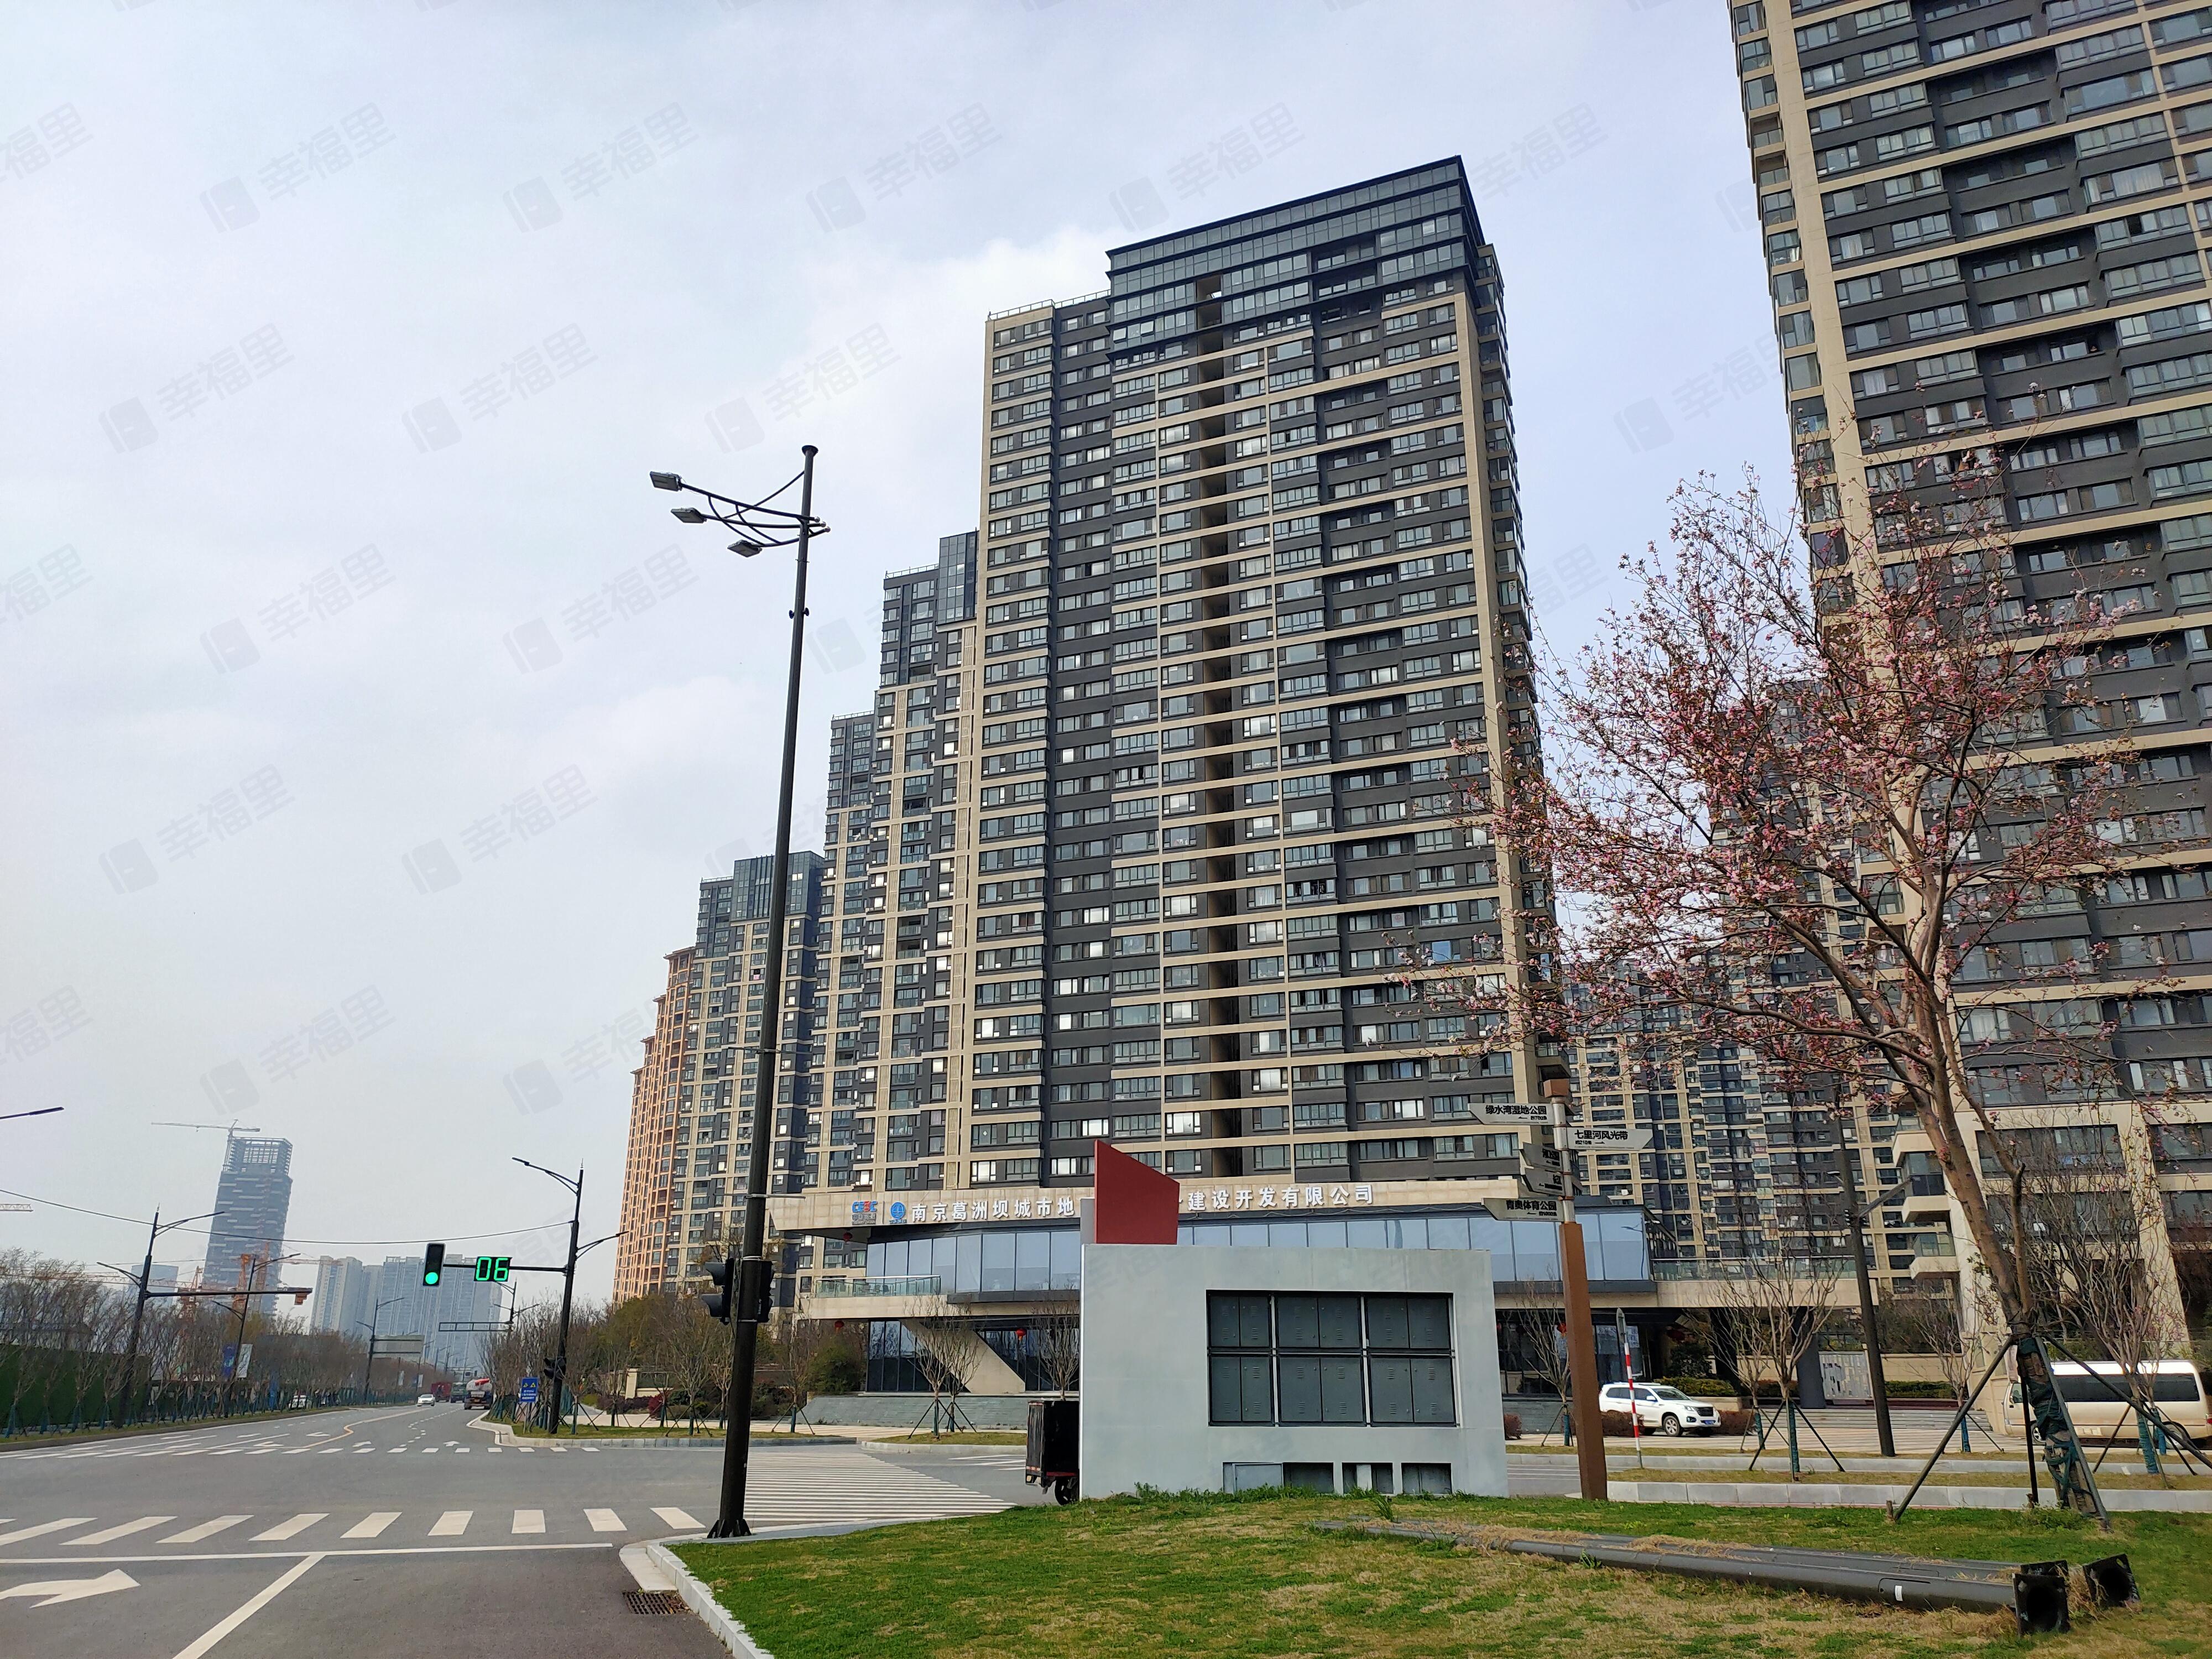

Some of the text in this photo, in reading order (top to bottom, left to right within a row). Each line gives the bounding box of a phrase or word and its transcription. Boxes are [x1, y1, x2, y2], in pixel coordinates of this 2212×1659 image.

[1485, 1105, 1547, 1115] 绿水湾湿地公园
[1574, 1129, 1628, 1140] 七里河风光带
[476, 1257, 508, 1281] 06
